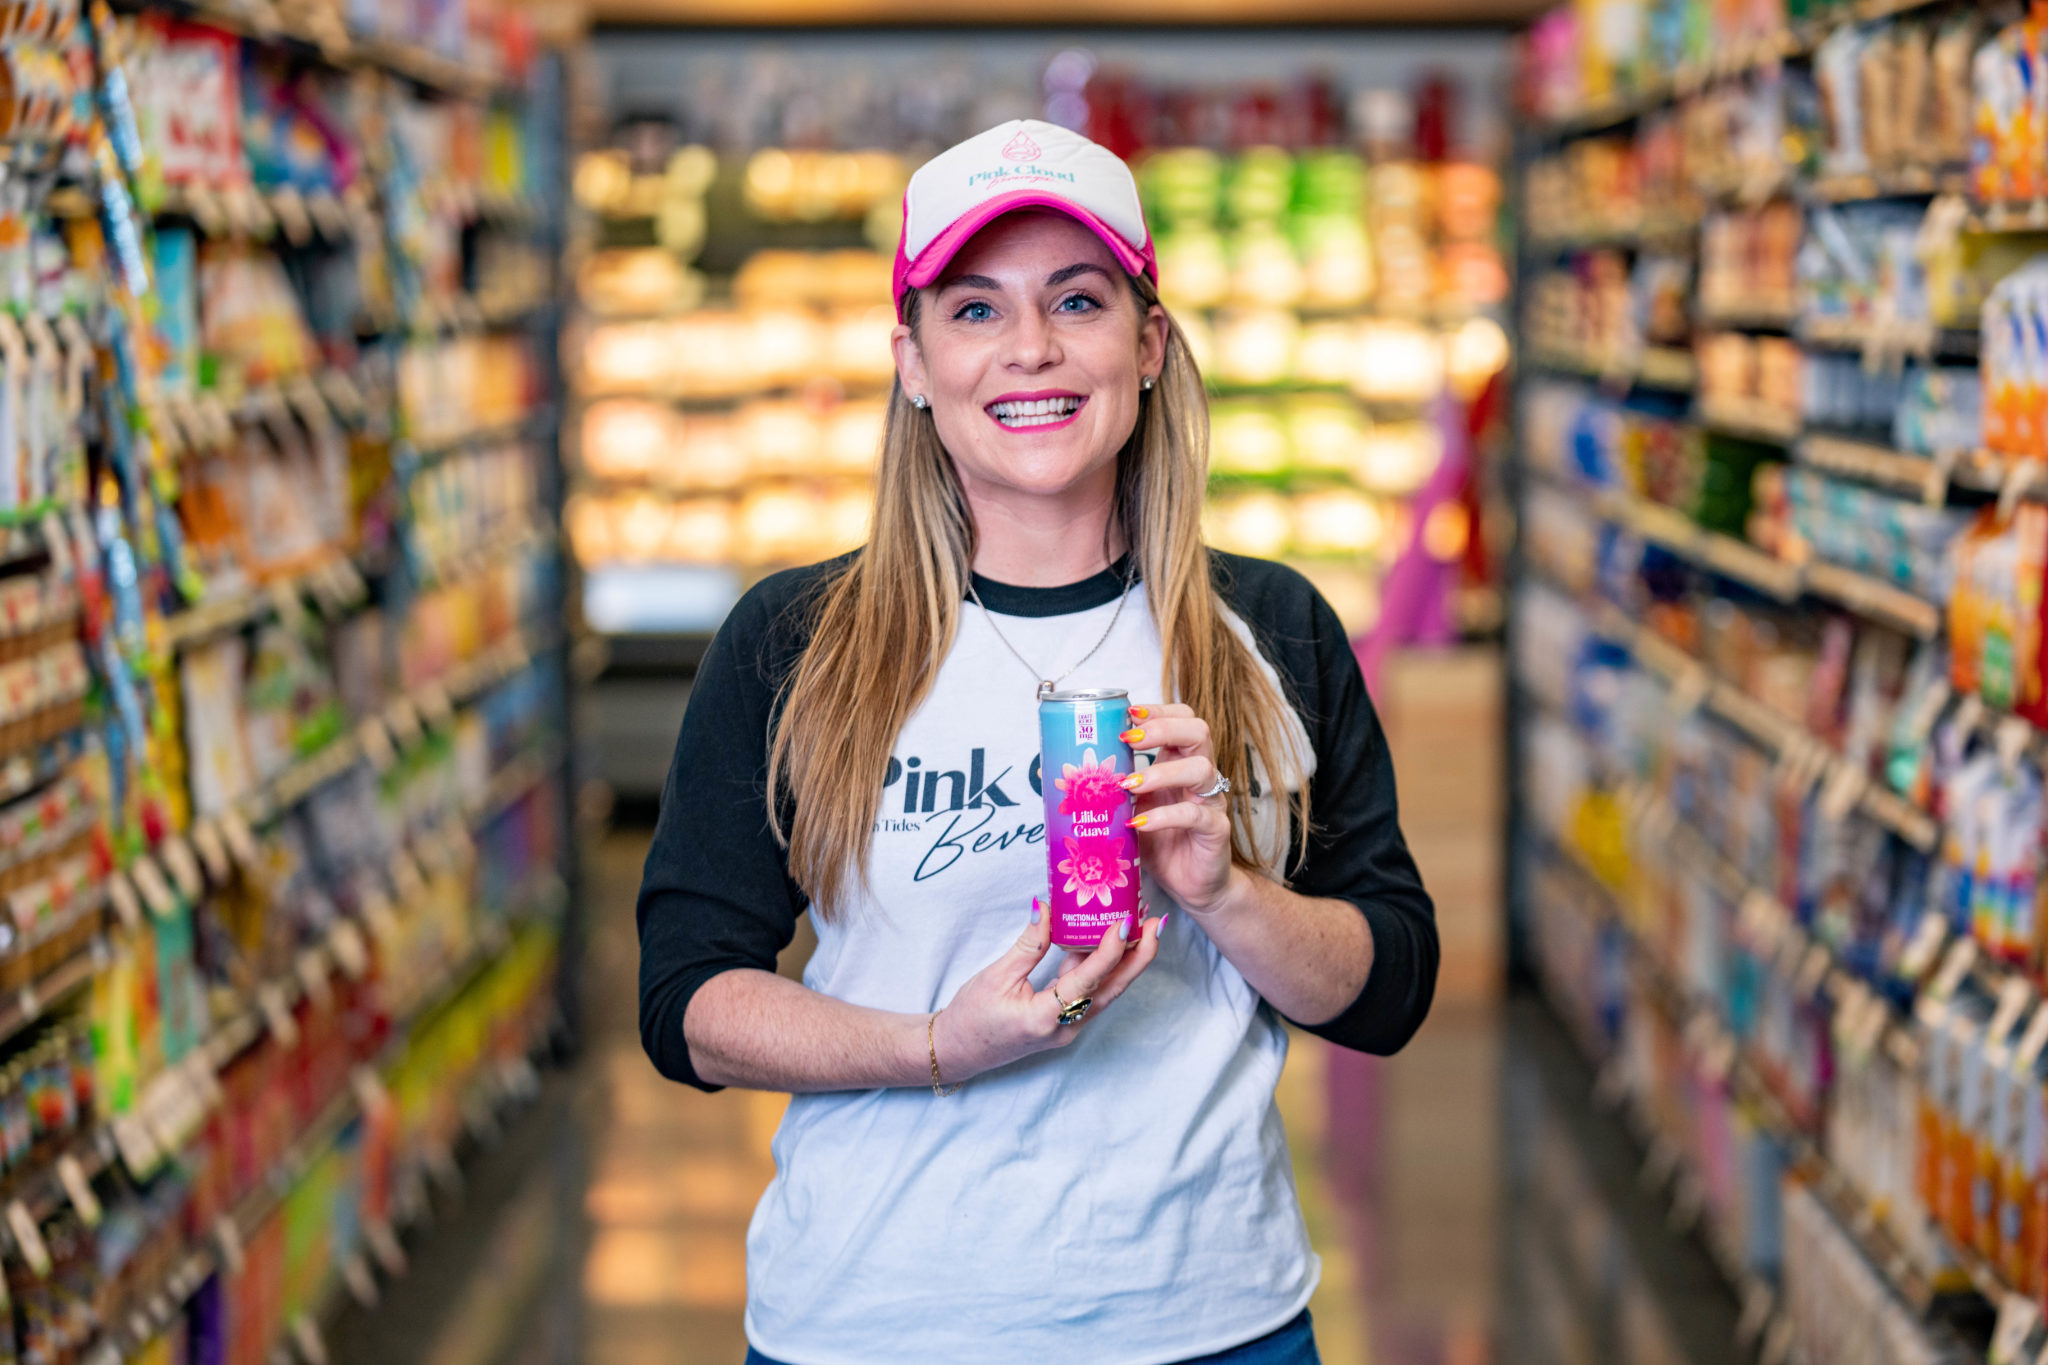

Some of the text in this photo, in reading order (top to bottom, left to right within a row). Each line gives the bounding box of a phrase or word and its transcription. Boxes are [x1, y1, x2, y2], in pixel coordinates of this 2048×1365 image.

[969, 165, 1074, 186] Pink Cloud
[1073, 810, 1108, 823] Lilikoi
[884, 818, 921, 832] Tides
[1074, 825, 1110, 837] Guava
[1062, 913, 1099, 921] FUNCTIONAL
